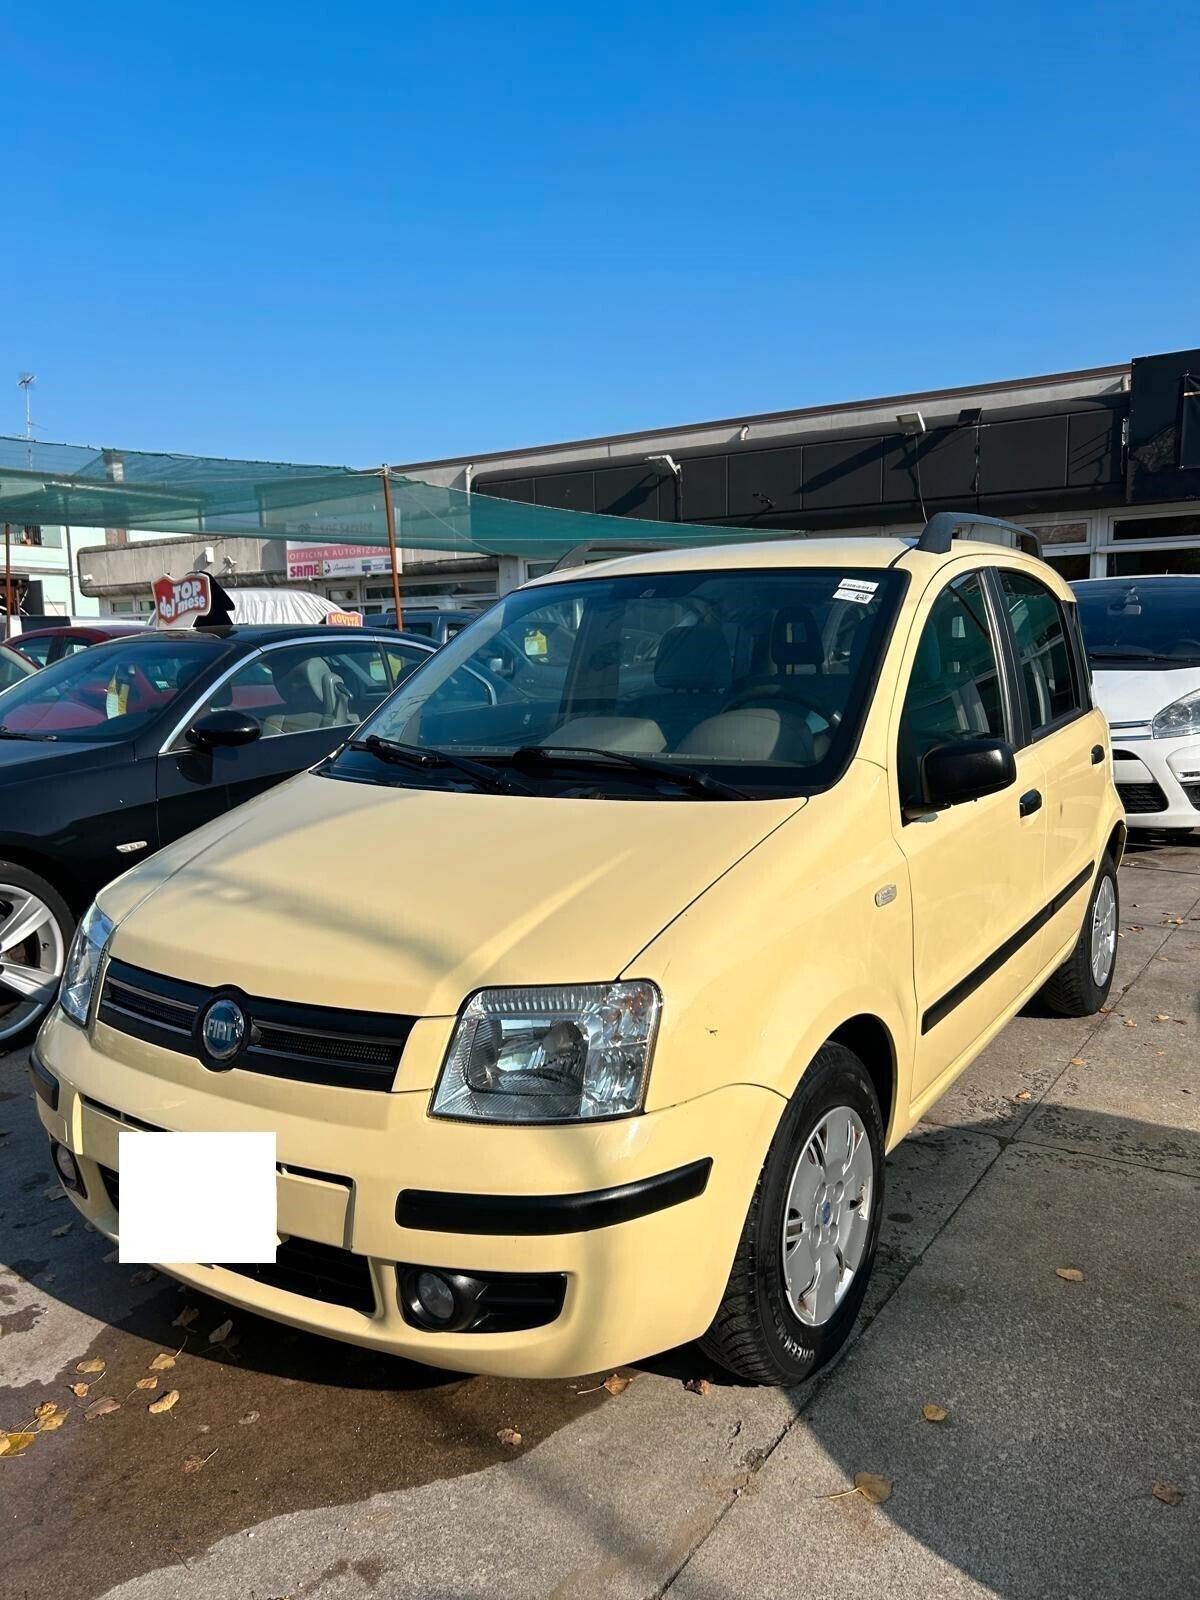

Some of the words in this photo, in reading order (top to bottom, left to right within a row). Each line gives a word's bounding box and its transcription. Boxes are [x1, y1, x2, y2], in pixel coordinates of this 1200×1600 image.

[289, 551, 329, 561] OFFICINA
[332, 547, 389, 558] AUTORIZZAT
[290, 564, 319, 577] SAME
[172, 581, 202, 604] TOP
[159, 596, 175, 618] del
[177, 595, 206, 615] mese
[206, 1018, 236, 1041] FIAT
